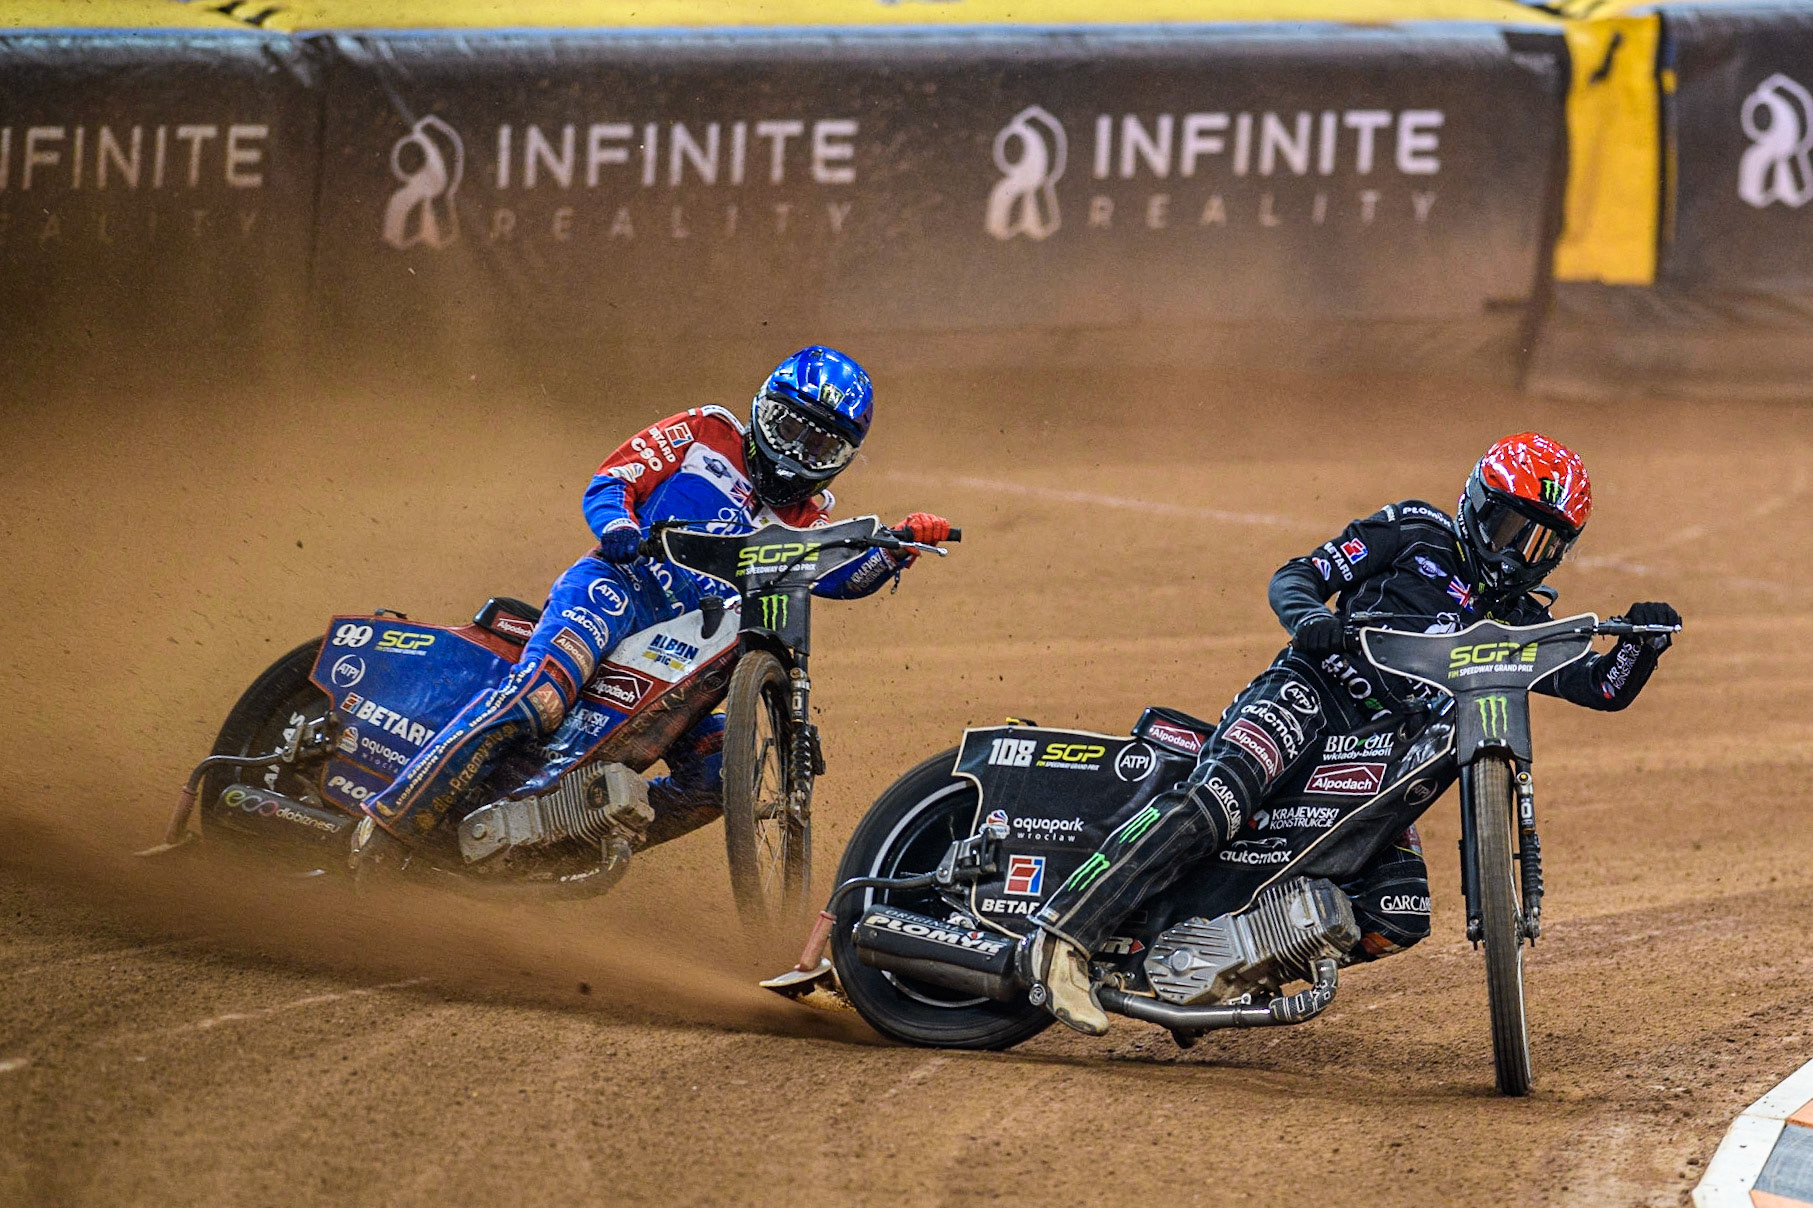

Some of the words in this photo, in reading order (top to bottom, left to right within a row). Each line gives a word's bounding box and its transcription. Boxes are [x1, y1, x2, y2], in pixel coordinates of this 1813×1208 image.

[497, 119, 860, 189] INFINITE
[1094, 110, 1445, 179] INFINITE
[0, 124, 268, 190] FINITE
[1088, 190, 1437, 228] REALITY
[490, 203, 852, 241] REALITY
[332, 624, 374, 648] 99
[378, 630, 436, 649] SGP
[337, 663, 360, 679] ATPI
[1459, 665, 1494, 677] SPEEDWAY
[1494, 664, 1518, 673] GRAND
[1518, 664, 1534, 673] PRIX
[1288, 688, 1312, 709] ATPI
[1151, 729, 1197, 751] Alpodach
[1324, 735, 1358, 752] BIO
[988, 738, 1037, 767] 108
[1042, 743, 1106, 762] SGP
[1120, 755, 1150, 770] ATPI
[1230, 730, 1275, 774] Alpodach
[1312, 778, 1372, 791] Alpodach
[1270, 817, 1334, 830] KONSTRUKCJE
[1272, 807, 1340, 820] KRAJEWSKI
[1013, 817, 1084, 833] aquapark
[885, 909, 958, 931] ORIGINAL
